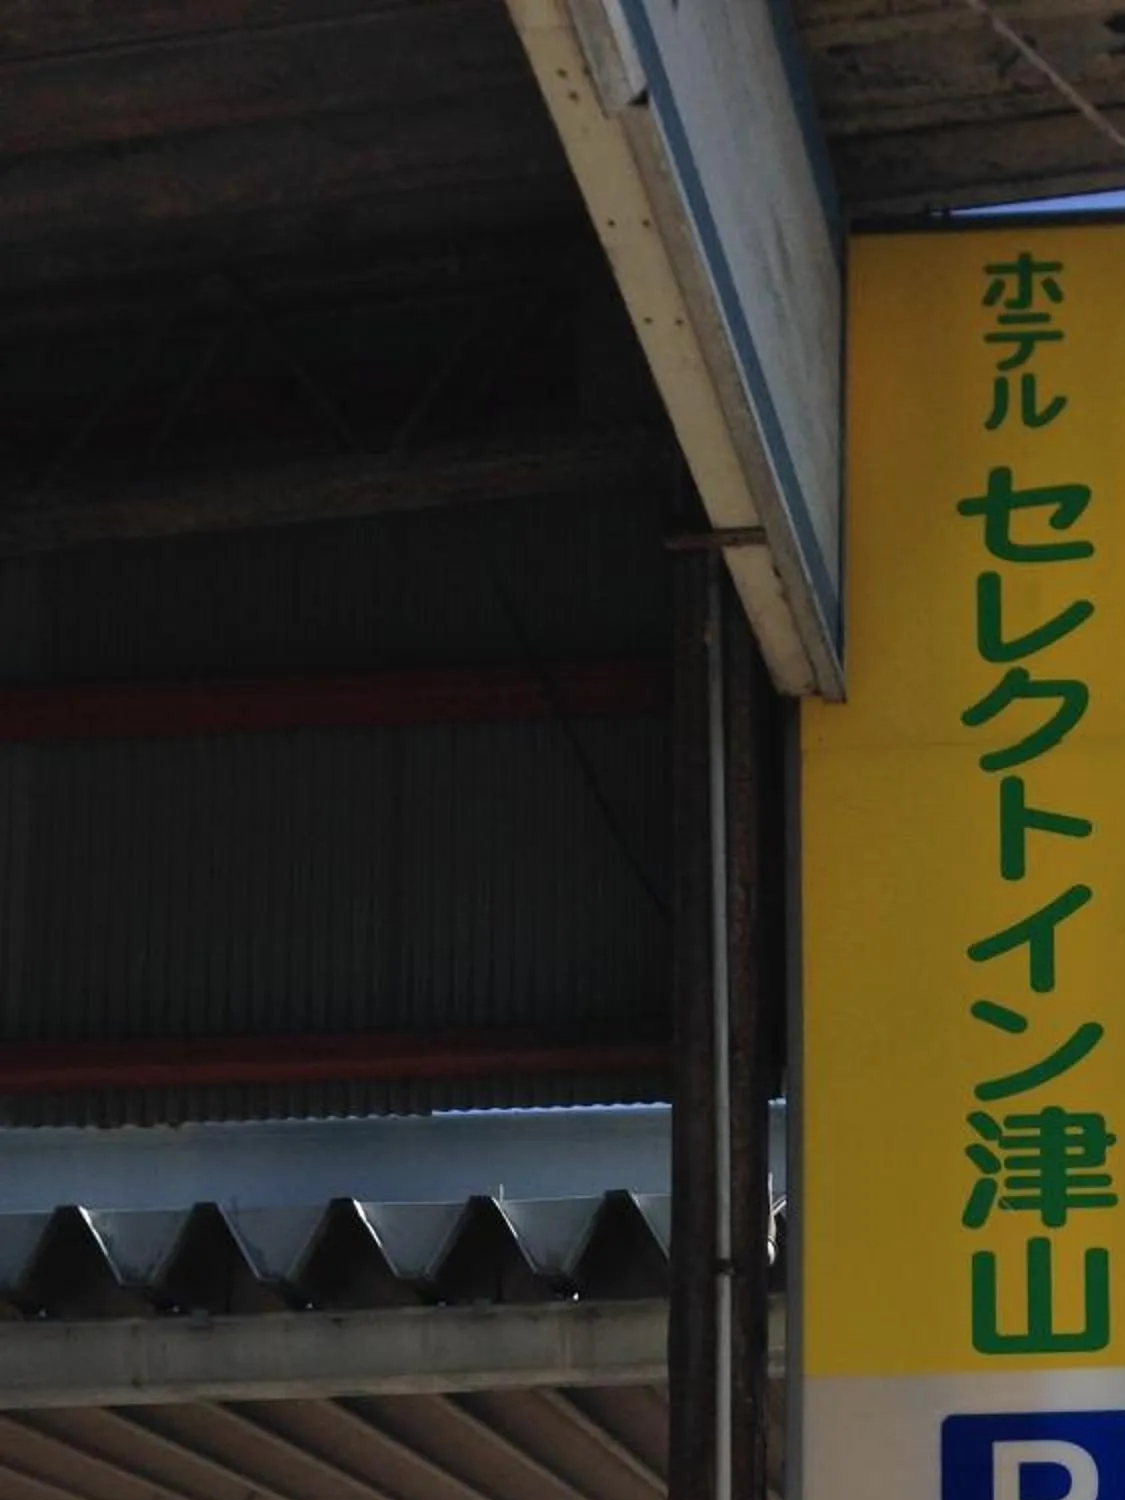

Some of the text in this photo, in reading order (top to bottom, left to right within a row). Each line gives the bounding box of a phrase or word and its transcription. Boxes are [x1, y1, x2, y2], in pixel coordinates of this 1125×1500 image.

[982, 252, 1066, 431] ホテル
[957, 465, 1118, 1355] セレクトイン津山
